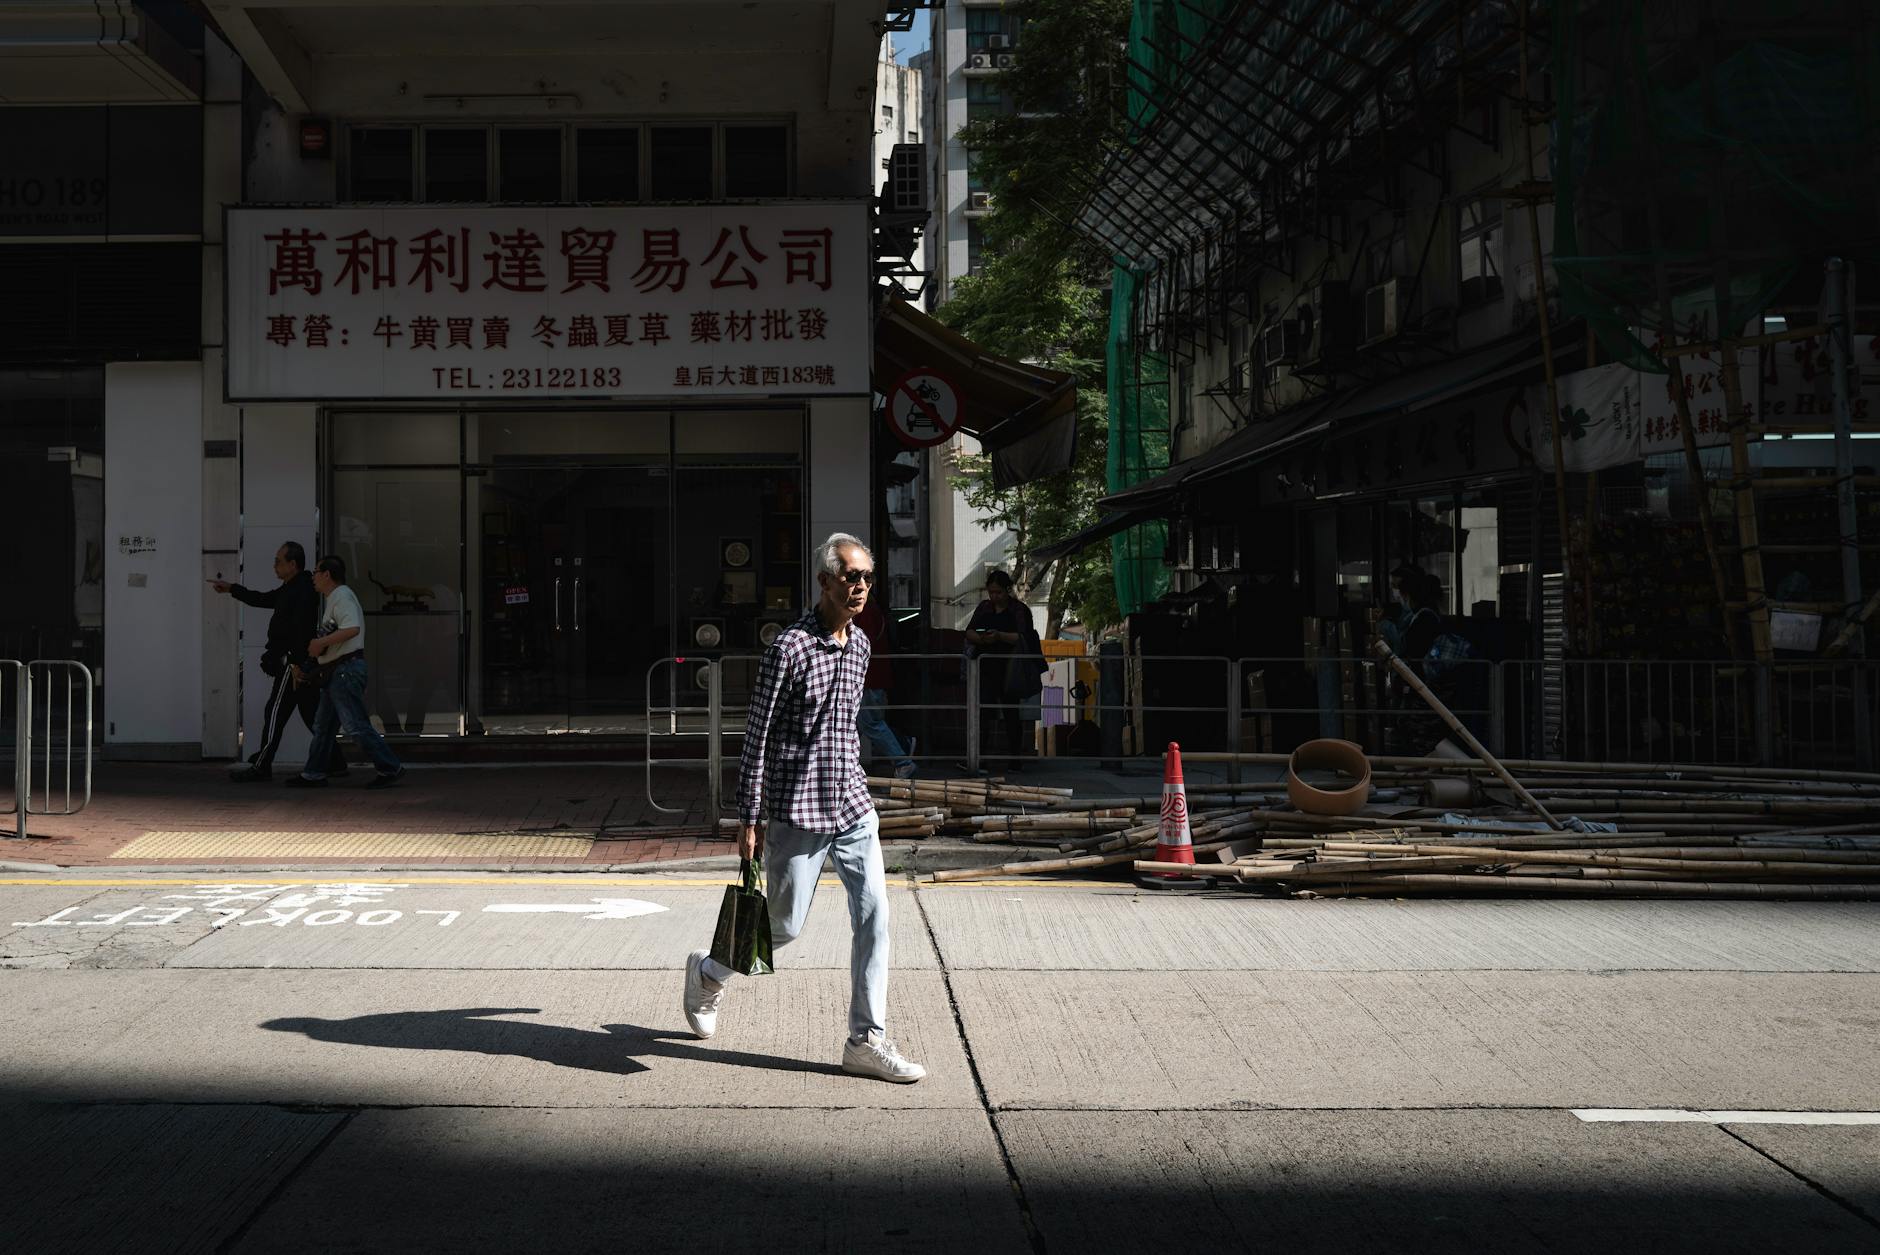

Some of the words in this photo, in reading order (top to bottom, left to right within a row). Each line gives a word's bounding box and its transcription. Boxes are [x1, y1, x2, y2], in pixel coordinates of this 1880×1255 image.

[55, 177, 105, 207] 189
[264, 225, 833, 296] 萬和利達貿易公司
[531, 312, 671, 350] 冬蟲夏草
[690, 307, 829, 344] 藥材批發
[673, 365, 835, 387] 皇后大道西183號
[10, 905, 246, 928] LEFT
[238, 908, 462, 928] LOOK
